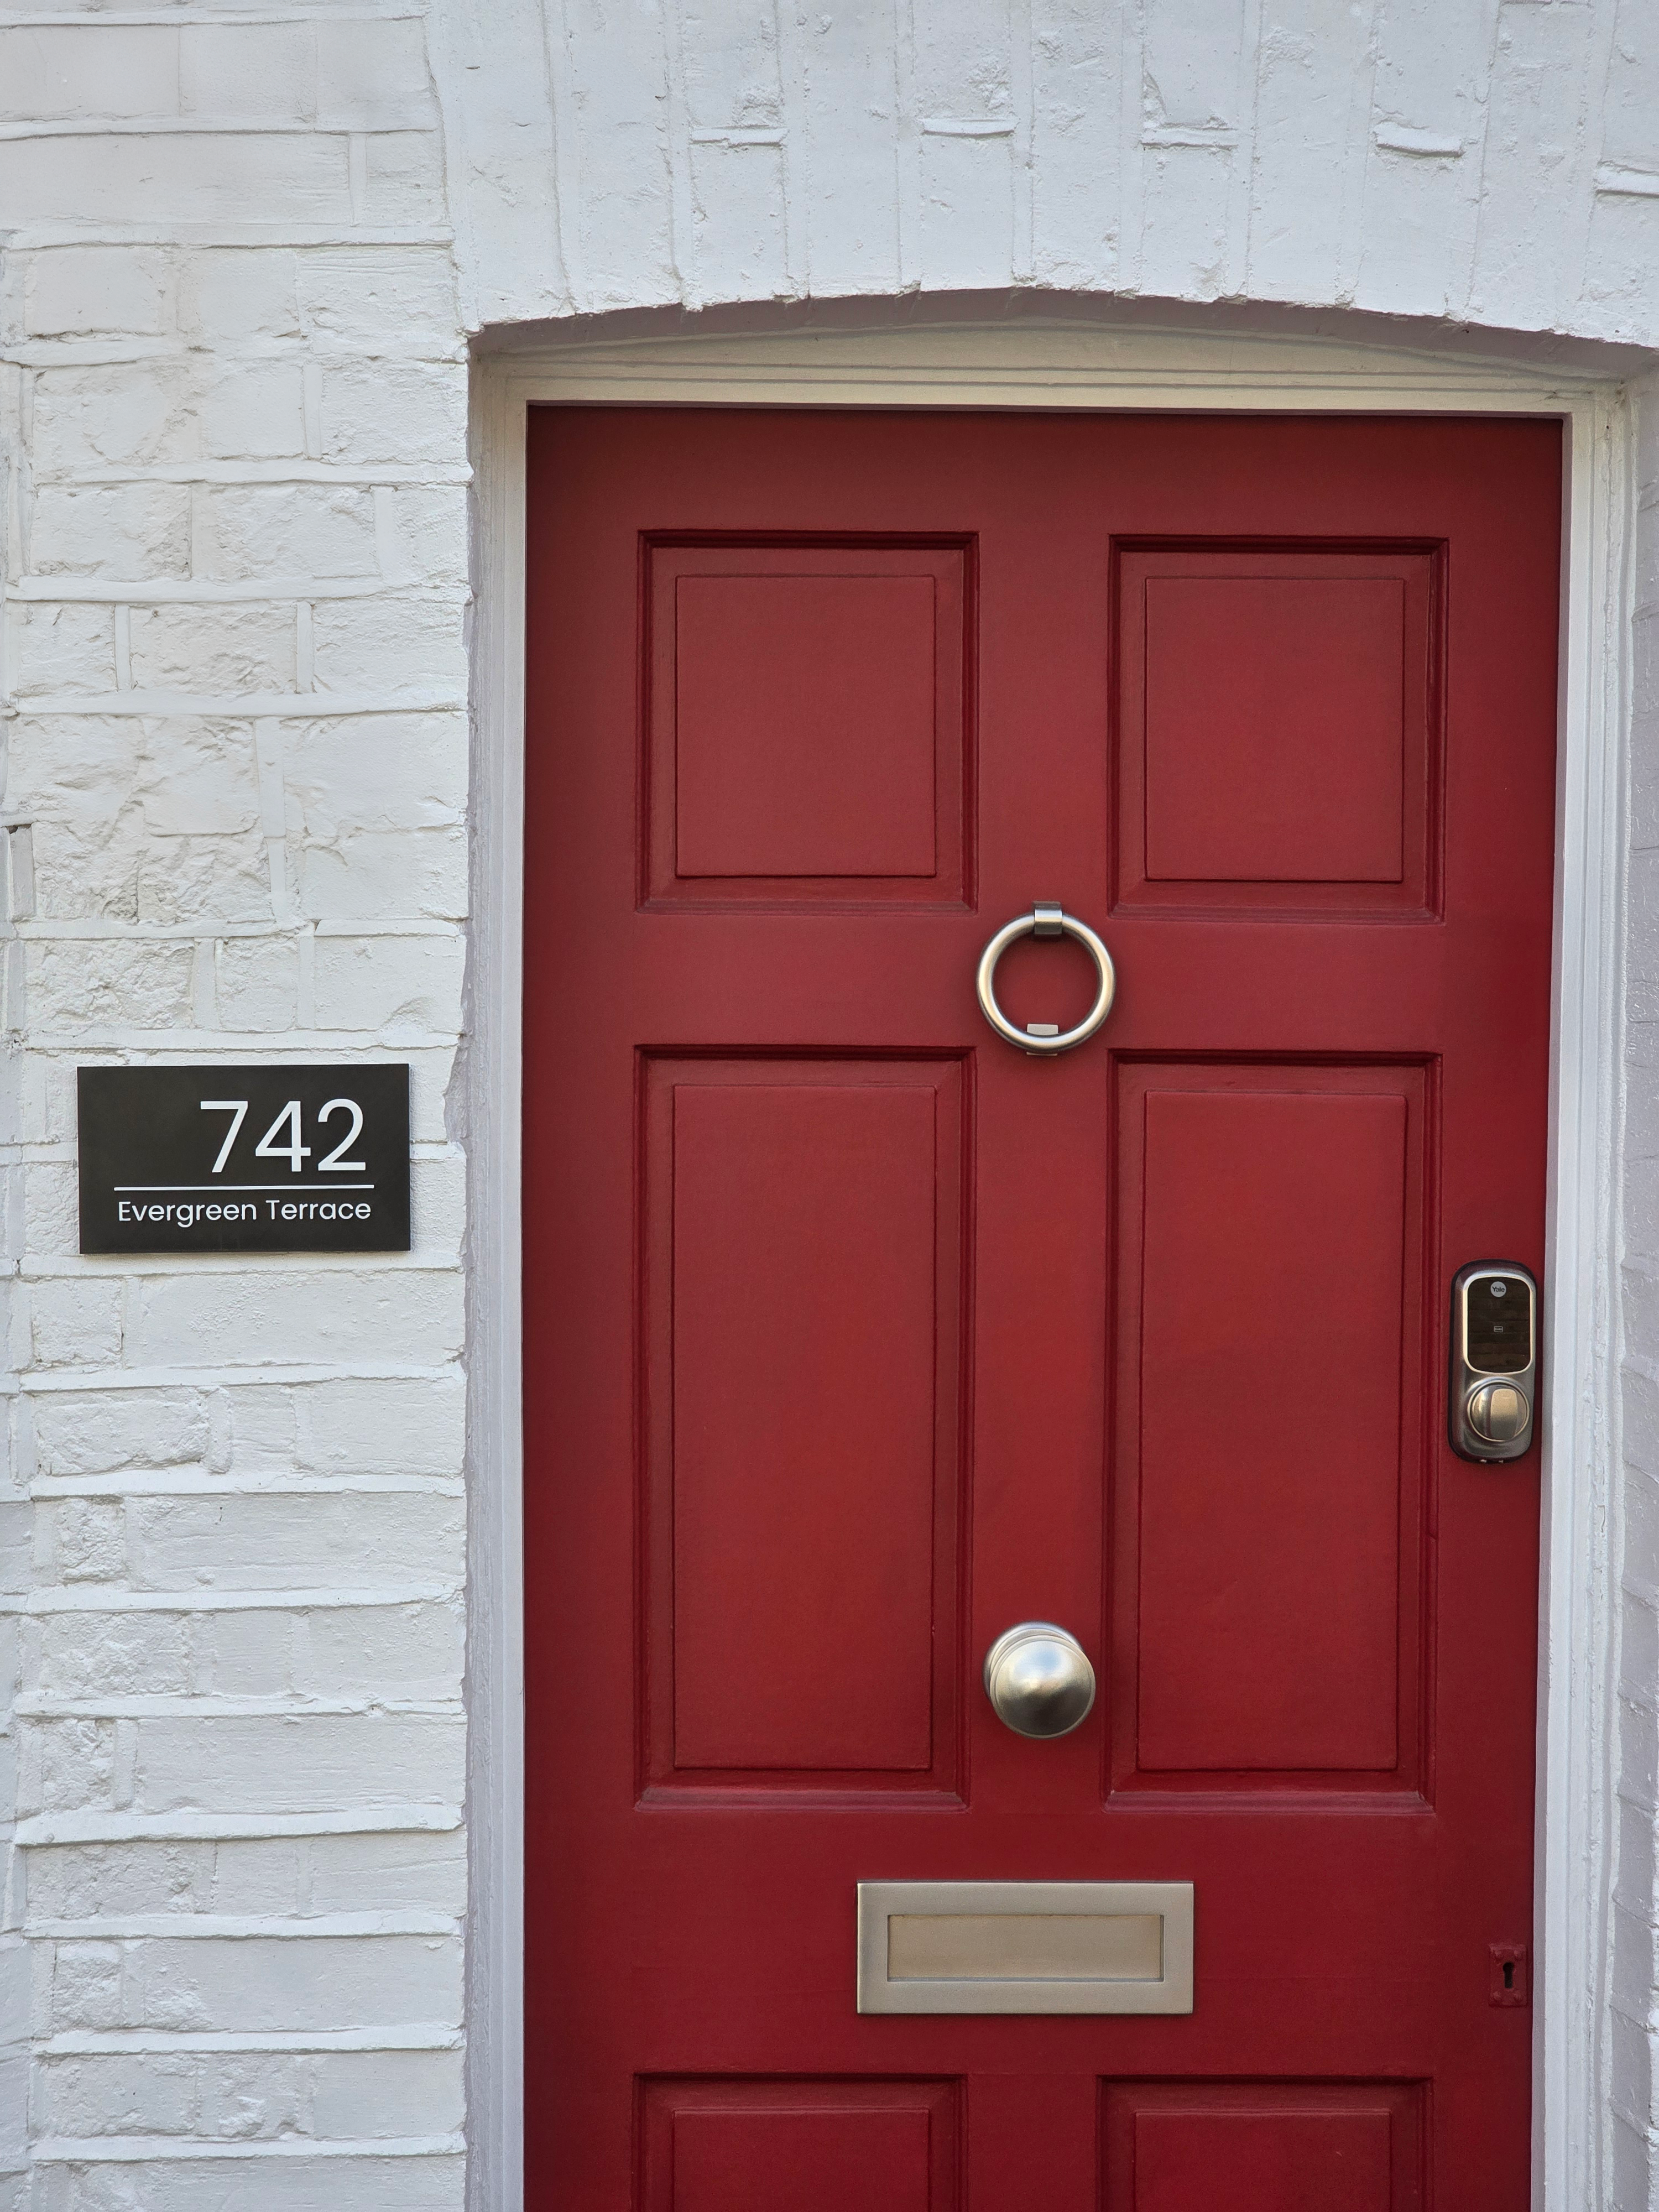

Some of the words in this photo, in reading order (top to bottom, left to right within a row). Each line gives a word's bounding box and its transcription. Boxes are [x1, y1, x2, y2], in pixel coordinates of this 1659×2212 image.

[200, 1098, 366, 1173] 742
[118, 1201, 257, 1228] Evergreen
[265, 1199, 371, 1220] Terrace
